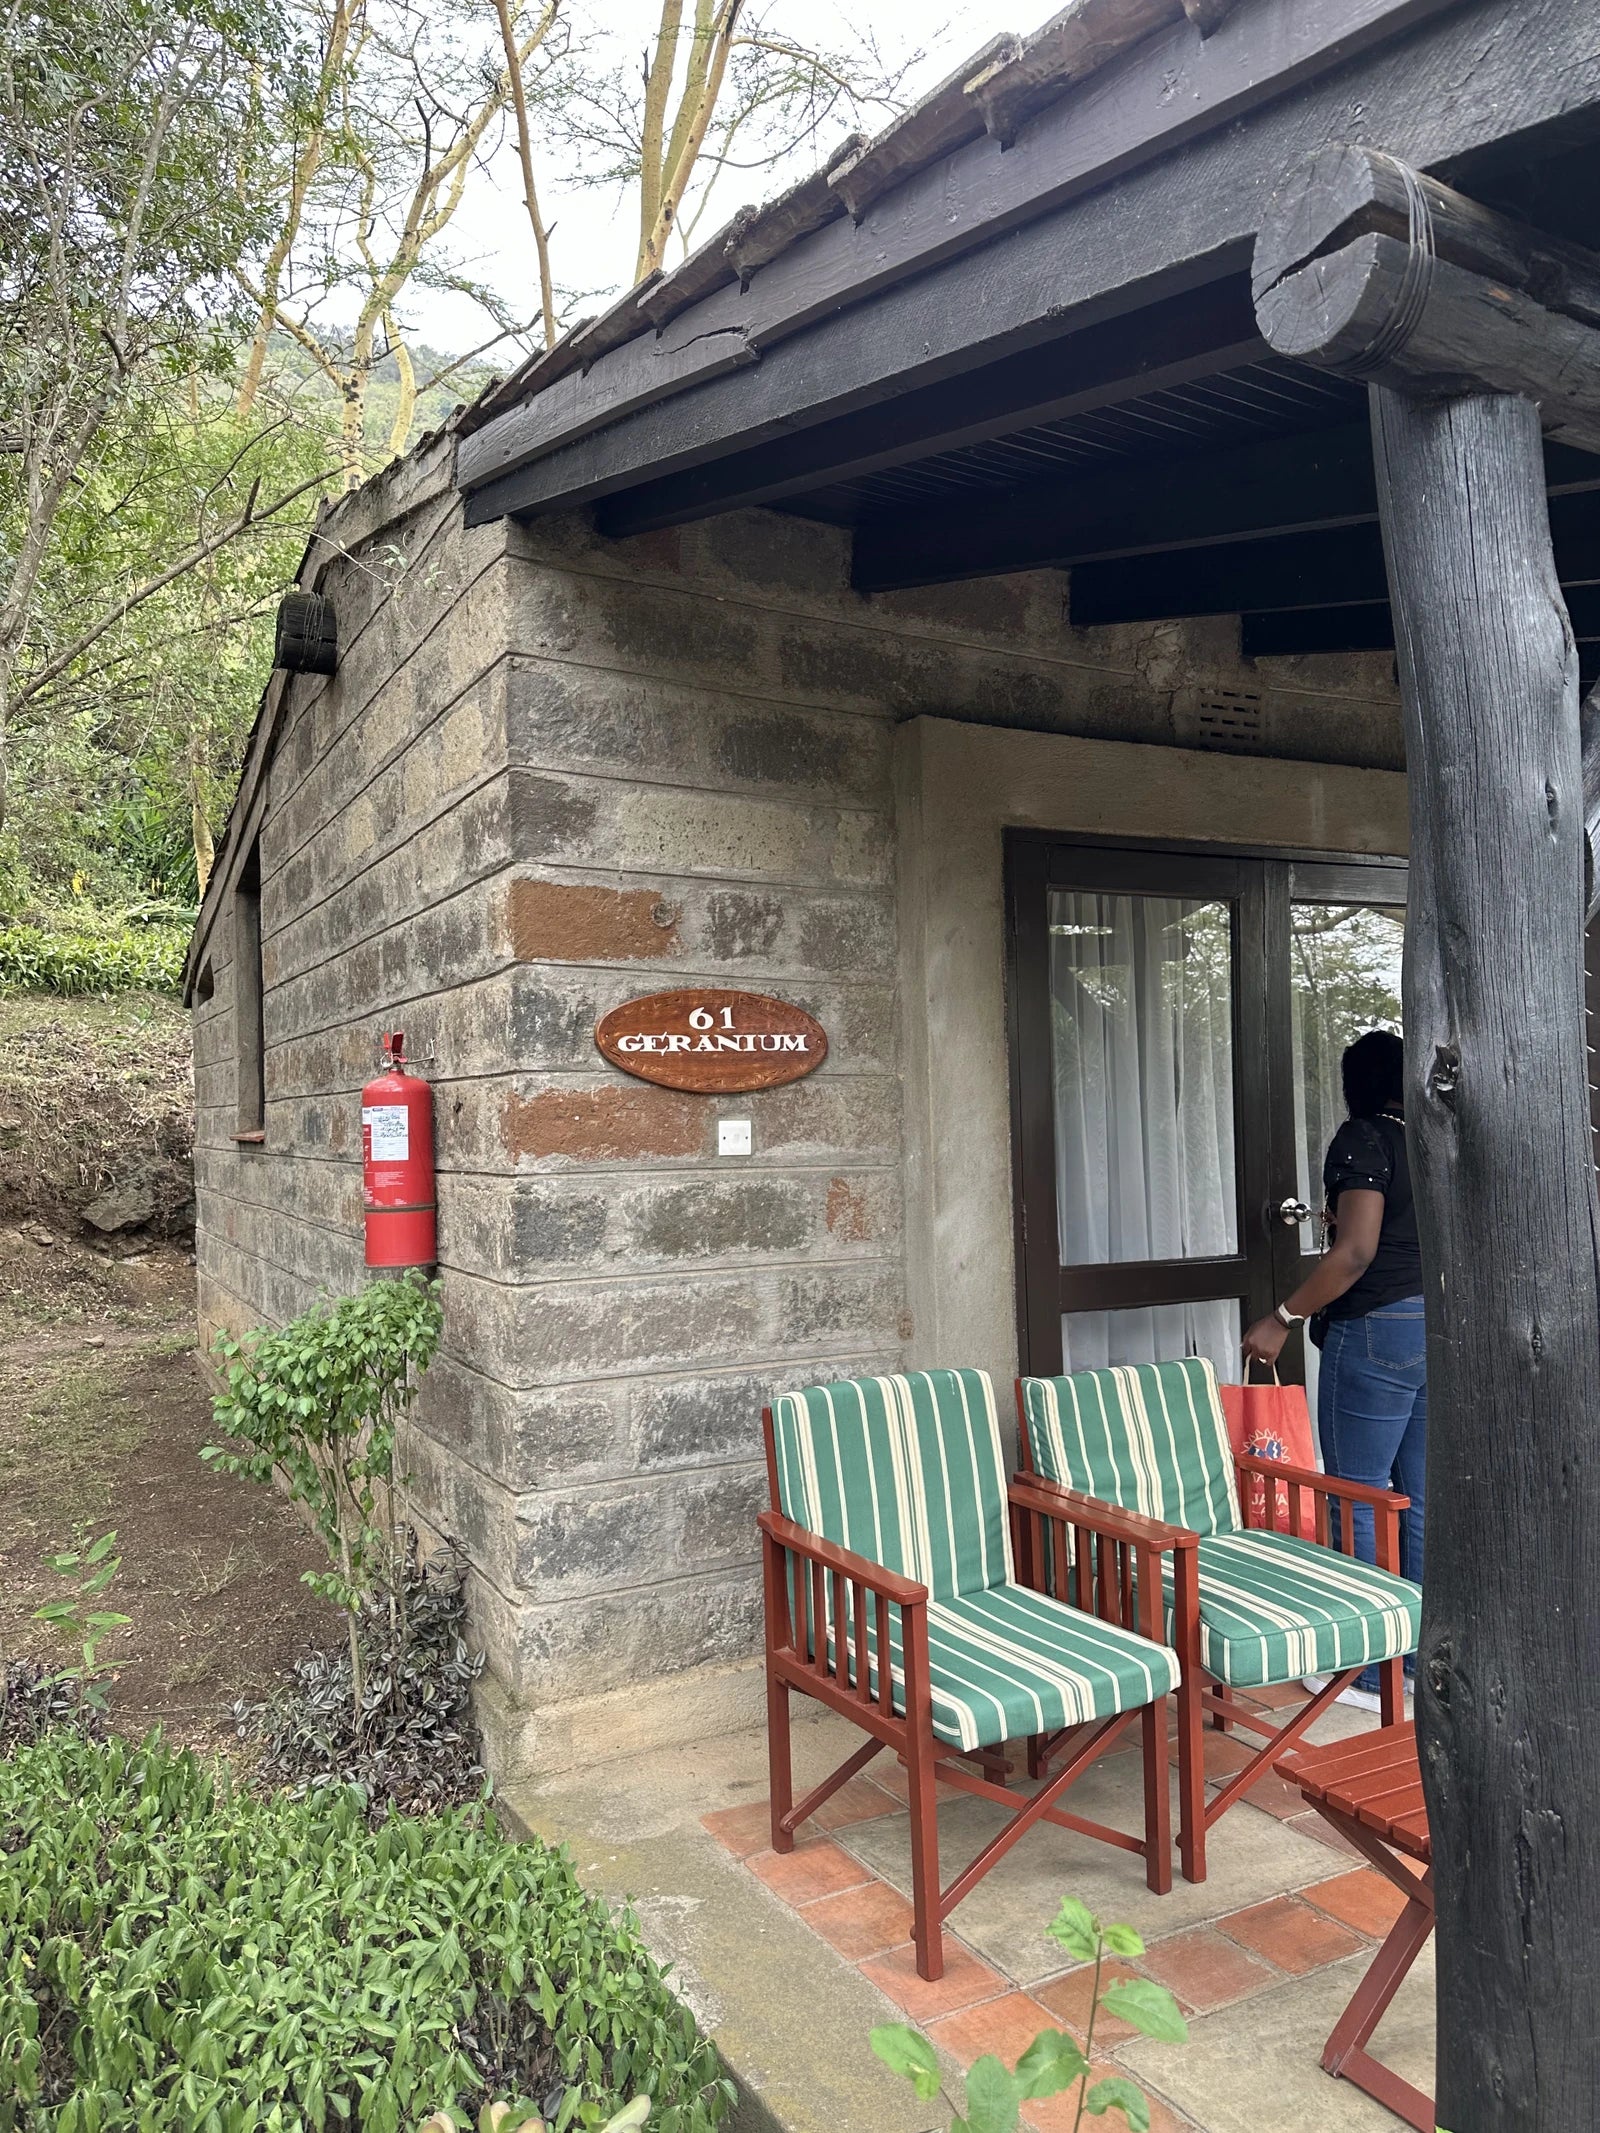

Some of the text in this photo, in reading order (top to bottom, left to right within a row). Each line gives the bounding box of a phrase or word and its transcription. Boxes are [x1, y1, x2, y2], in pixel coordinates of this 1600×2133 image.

[689, 1006, 736, 1030] 61
[617, 1032, 809, 1056] GERANIUM
[1251, 1493, 1288, 1506] JAA
